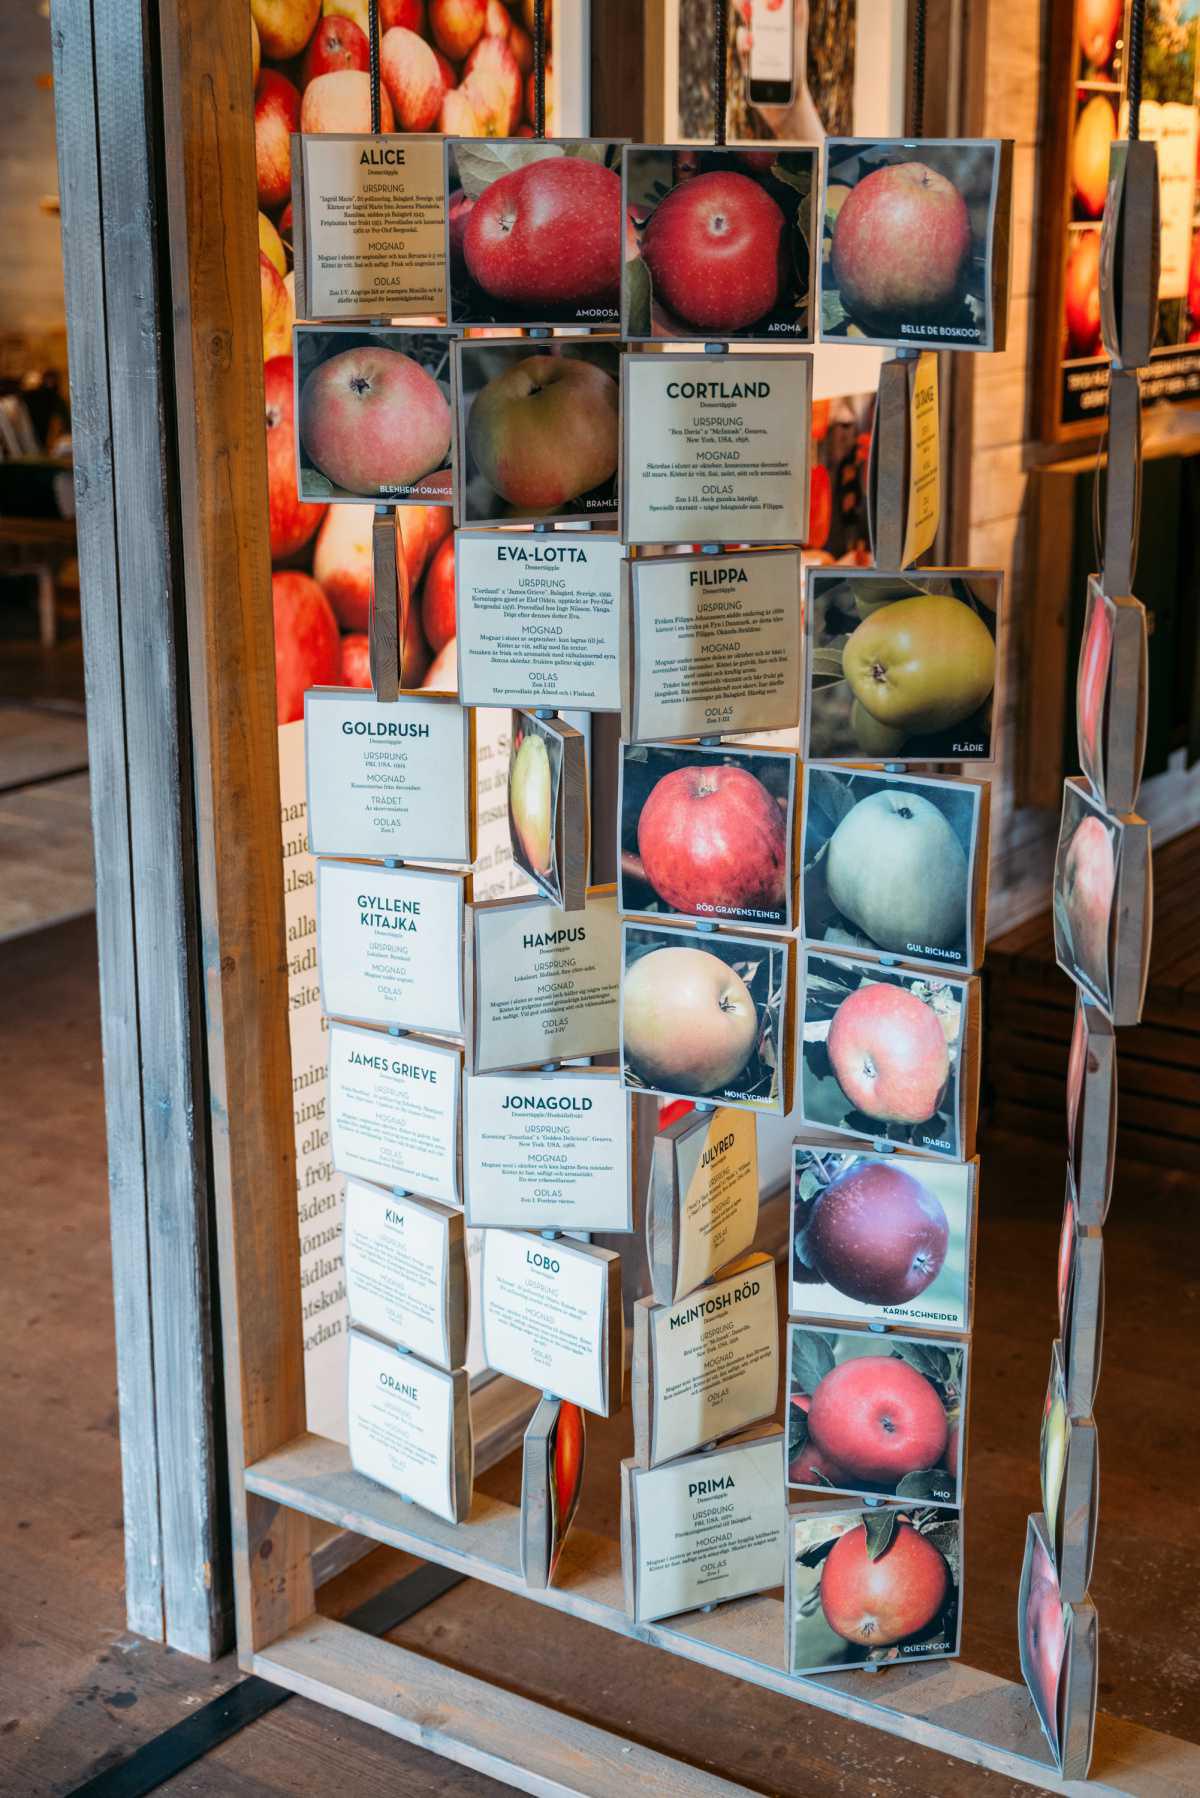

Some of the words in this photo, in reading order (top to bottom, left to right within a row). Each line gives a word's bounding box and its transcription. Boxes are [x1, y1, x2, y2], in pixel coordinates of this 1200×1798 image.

[360, 149, 406, 165] ALICE
[362, 184, 405, 193] URSPRUNG
[368, 241, 404, 251] MOGNAD
[374, 277, 401, 286] ODLAS
[575, 309, 619, 317] AMOROSA
[768, 323, 801, 332] AROMA
[901, 324, 926, 334] BELLE
[927, 326, 938, 335] DE
[940, 327, 980, 338] BOSKOOP
[666, 382, 771, 398] CORTLAND
[693, 417, 743, 427] URSPRUNG
[696, 451, 740, 460] MOGNAD
[380, 485, 419, 494] BLENHEIM
[702, 485, 733, 494] ODLAS
[497, 546, 587, 562] EVA-LOTTA
[518, 579, 566, 588] URSPRUNG
[690, 568, 748, 586] FILIPPA
[697, 601, 743, 613] URSPRUNG
[522, 626, 563, 634] MOGNAD
[701, 643, 741, 653] MOGNAD
[528, 672, 559, 681] ODLAS
[704, 706, 734, 717] ODLAS
[342, 721, 430, 737] GOLDRUSH
[952, 741, 984, 752] FLÄDIE
[363, 751, 408, 761] URSPRUNG
[367, 774, 406, 783] MOGNAD
[373, 818, 401, 827] ODLAS
[283, 833, 309, 858] nie
[357, 895, 421, 915] GYLLENE
[696, 902, 713, 912] RÖD
[715, 905, 781, 919] GRAVENSTEINER
[288, 916, 318, 942] alla
[360, 912, 417, 932] KITAJKA
[523, 927, 586, 948] HAMPUS
[906, 943, 923, 952] GUL
[925, 946, 961, 959] RICHARD
[534, 958, 577, 972] URSPRUNG
[537, 981, 575, 993] MOGNAD
[290, 984, 321, 1012] site
[541, 1017, 569, 1028] ODLAS
[348, 1051, 389, 1071] JAMES
[392, 1061, 437, 1084] GRIEVE
[502, 1095, 593, 1111] JONAGOLD
[524, 1125, 570, 1134] URSPRUNG
[922, 1136, 951, 1149] IDARED
[701, 1133, 735, 1168] JULYRED
[528, 1154, 568, 1163] MOGNAD
[534, 1188, 563, 1198] ODLAS
[385, 1208, 404, 1226] KIM
[300, 1221, 344, 1257] ömas
[526, 1250, 560, 1274] LOBO
[669, 1293, 732, 1330] McINTOSH
[734, 1280, 760, 1304] RÖD
[882, 1307, 908, 1316] KARIN
[910, 1309, 958, 1321] SCHNEIDER
[303, 1317, 343, 1352] edan
[700, 1321, 735, 1341] URSPRUNG
[704, 1351, 734, 1369] MOGNAD
[379, 1372, 418, 1401] ORANIE
[707, 1388, 729, 1402] ODLAS
[688, 1475, 735, 1498] PRIMA
[933, 1490, 950, 1499] MIO
[692, 1504, 735, 1520] URSPRUNG
[696, 1532, 733, 1547] MOGNAD
[700, 1560, 727, 1573] ODLAS
[903, 1644, 932, 1653] QUEEN
[933, 1642, 950, 1650] COX
